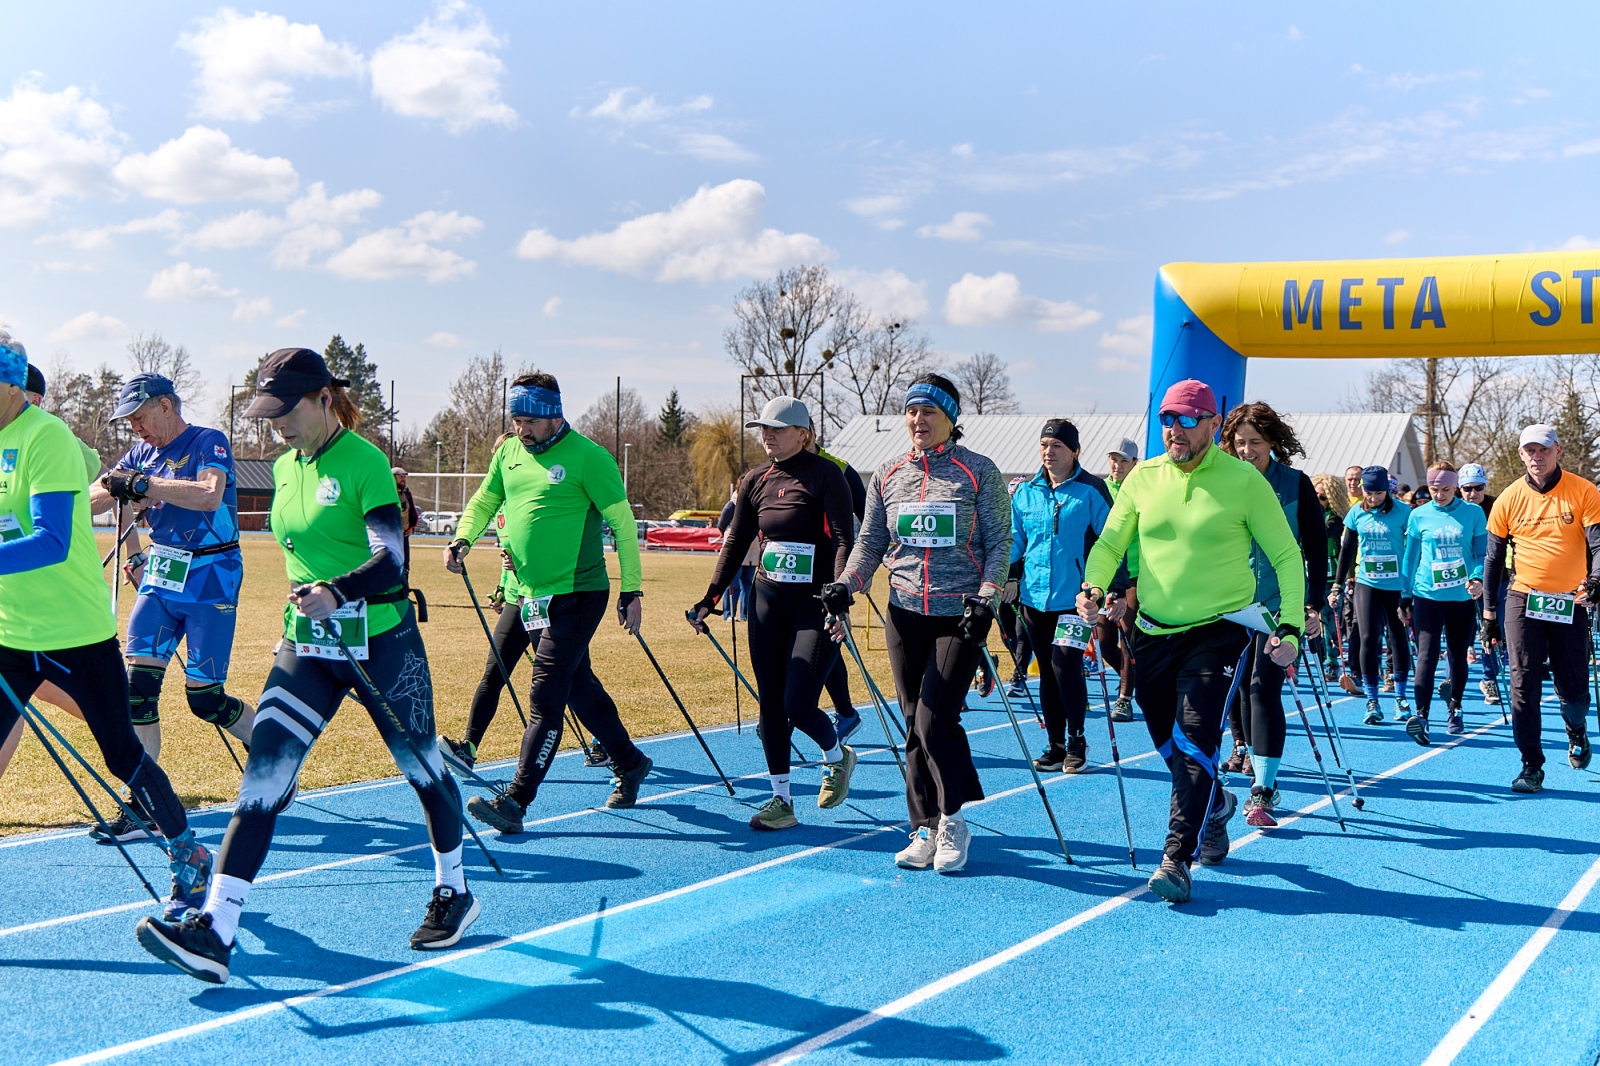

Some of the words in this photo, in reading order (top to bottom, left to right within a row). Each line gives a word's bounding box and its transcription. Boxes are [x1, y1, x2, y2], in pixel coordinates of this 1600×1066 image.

[1283, 276, 1446, 331] META
[1529, 269, 1600, 327] ST
[910, 515, 937, 532] 40
[152, 556, 172, 574] 84
[774, 553, 797, 569] 78
[1376, 562, 1384, 571] 5
[1441, 568, 1459, 580] 63
[527, 601, 540, 617] 39
[1535, 596, 1567, 612] 120
[1063, 623, 1084, 638] 33
